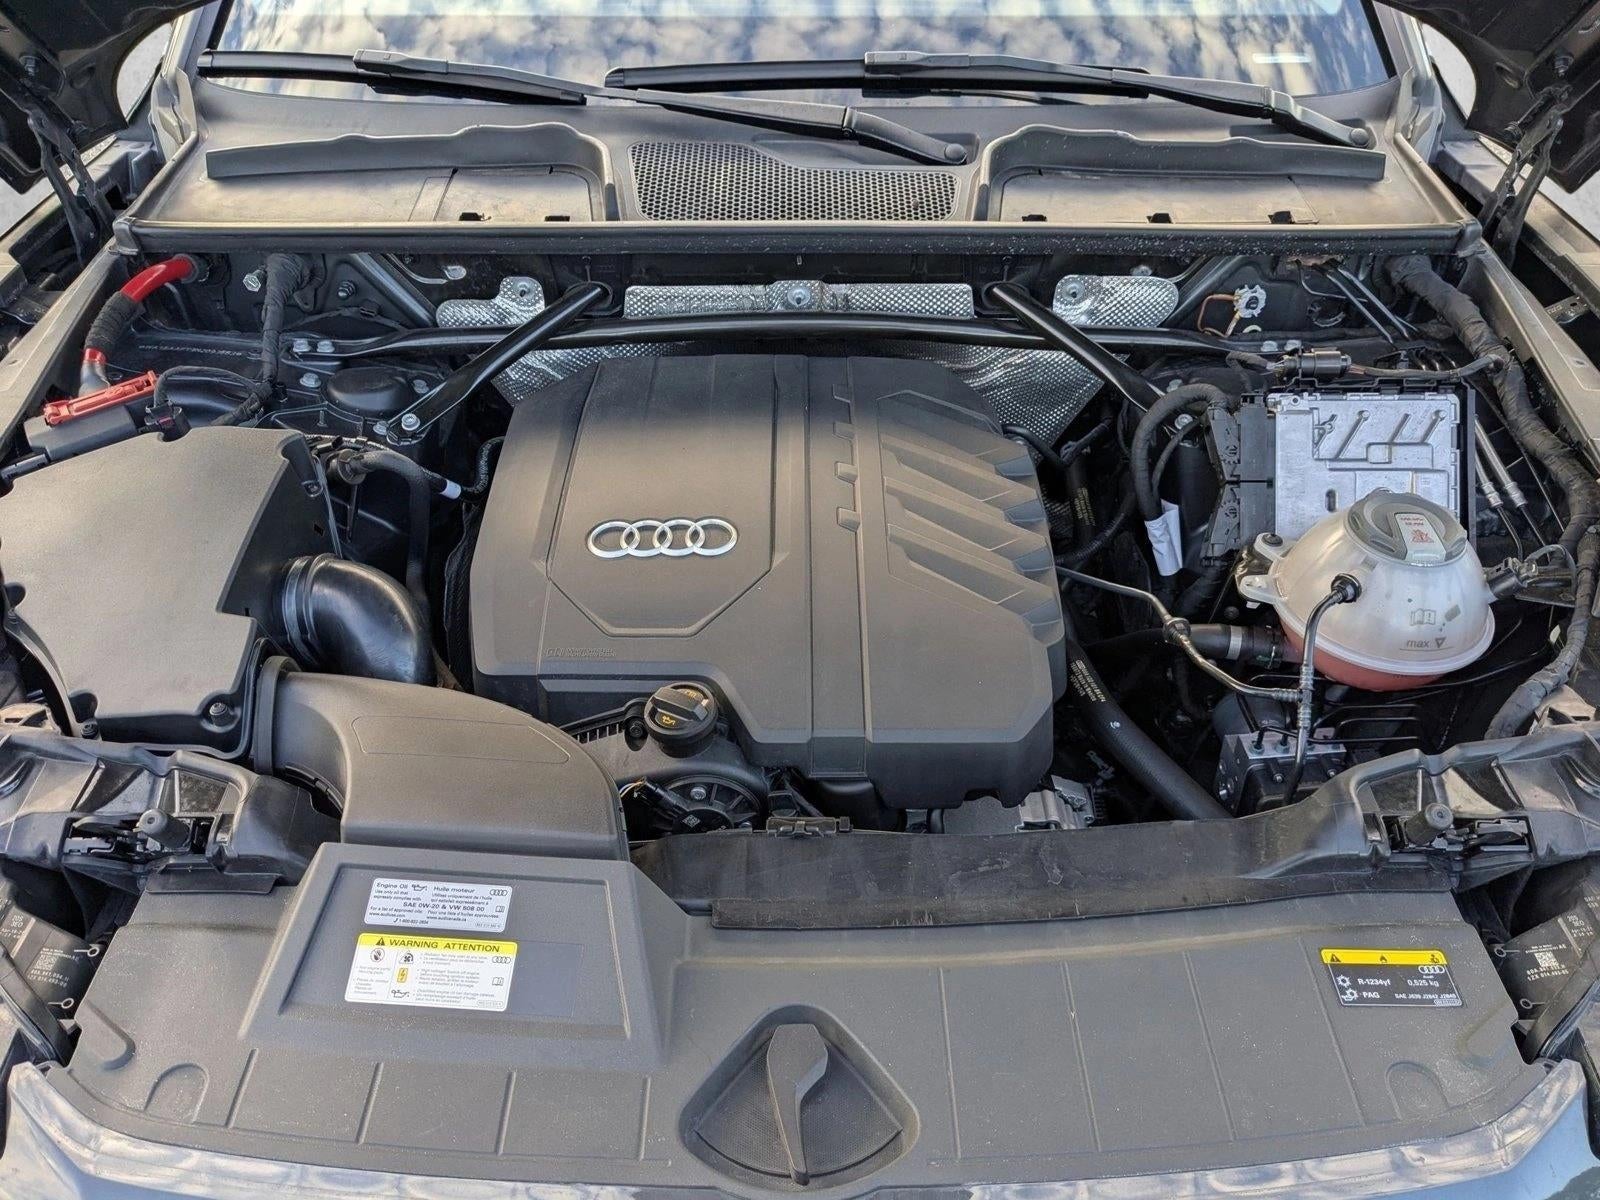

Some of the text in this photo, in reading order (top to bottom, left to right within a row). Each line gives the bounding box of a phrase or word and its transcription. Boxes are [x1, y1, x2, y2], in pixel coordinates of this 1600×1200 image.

[1407, 638, 1430, 648] max
[389, 939, 500, 953] WARNING ATTENTION
[1357, 978, 1391, 987] R-1234yf
[1362, 991, 1380, 999] PAG
